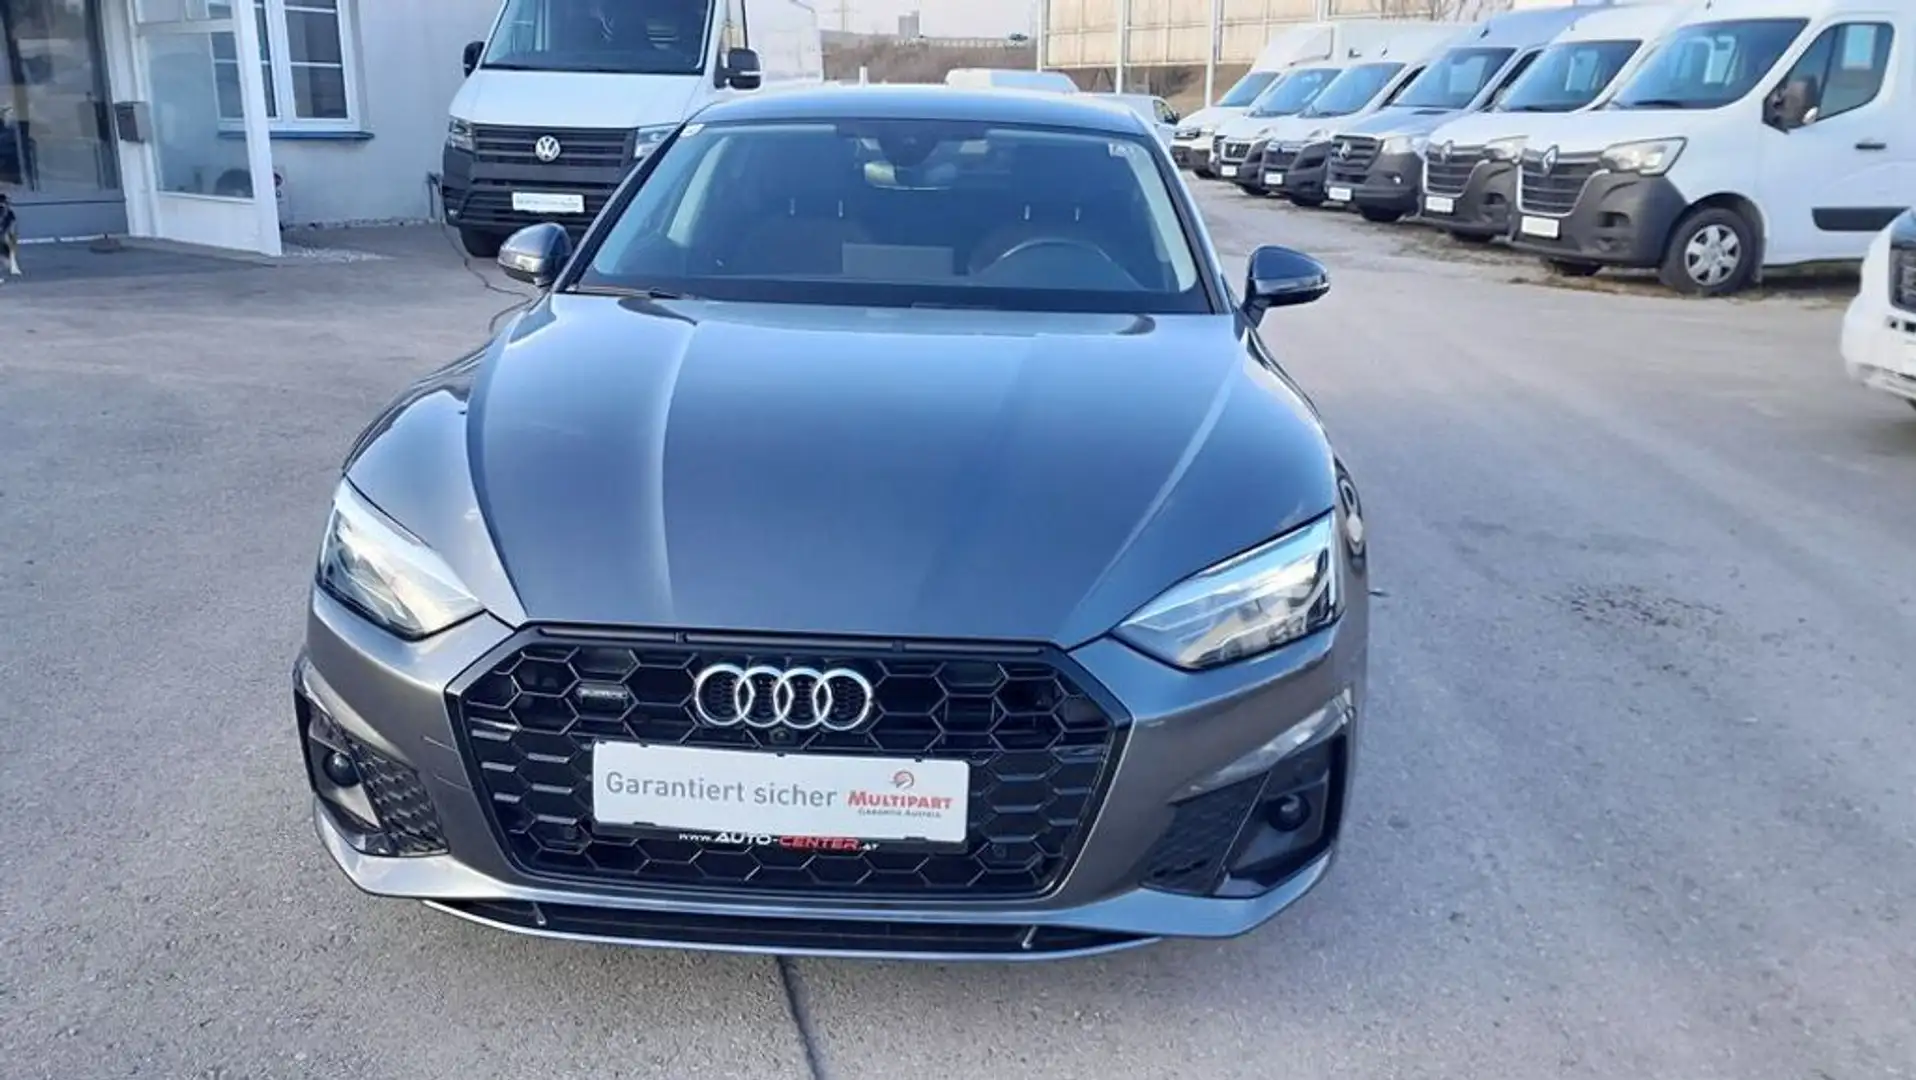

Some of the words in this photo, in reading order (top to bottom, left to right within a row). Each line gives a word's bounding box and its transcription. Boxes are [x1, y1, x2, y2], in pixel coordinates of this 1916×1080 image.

[605, 771, 745, 802] Garantiert
[753, 782, 838, 807] sicher
[847, 789, 953, 810] MULTIPART
